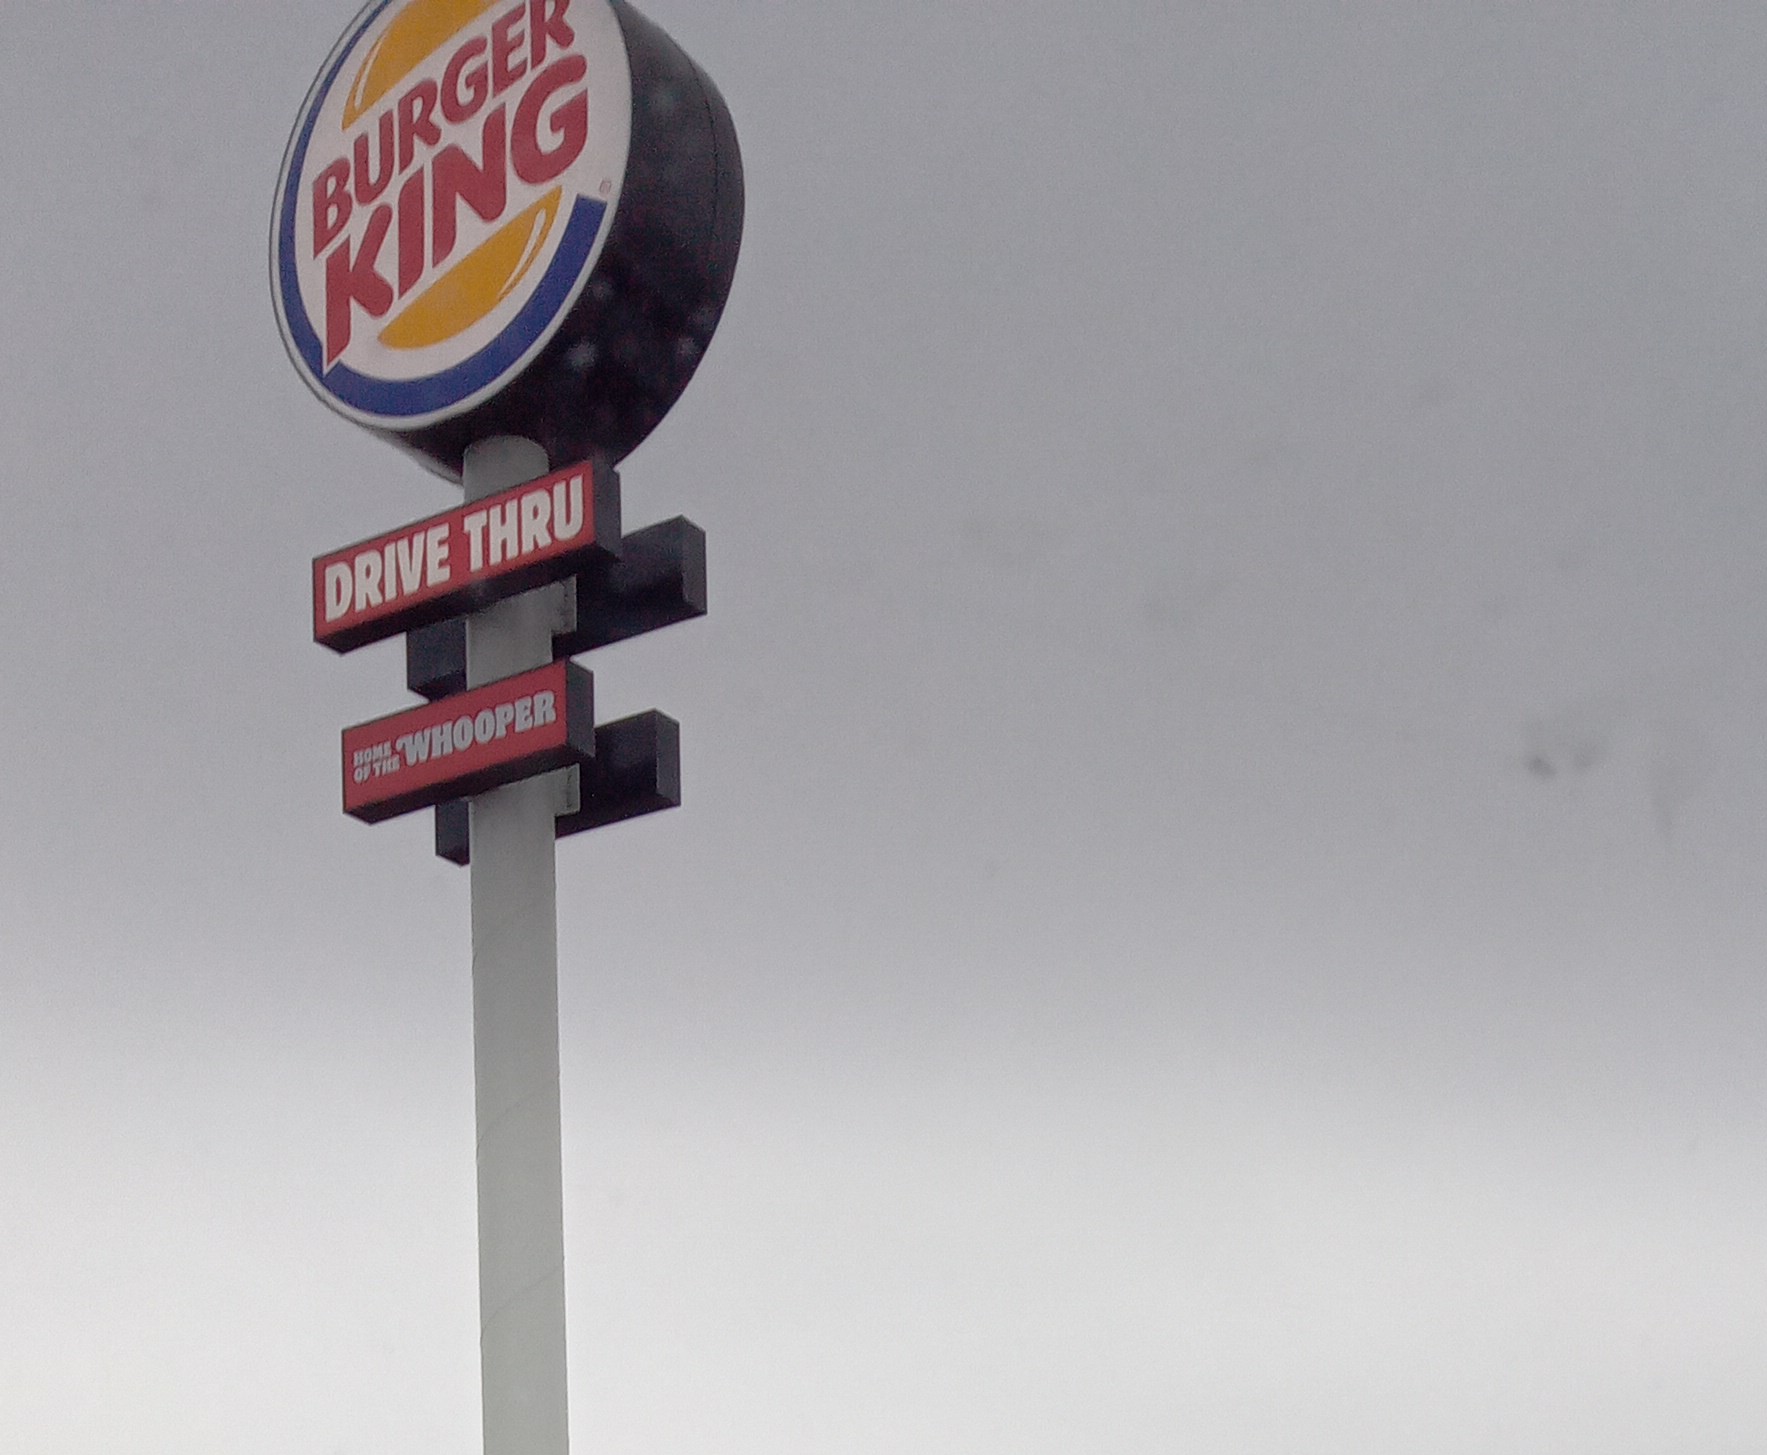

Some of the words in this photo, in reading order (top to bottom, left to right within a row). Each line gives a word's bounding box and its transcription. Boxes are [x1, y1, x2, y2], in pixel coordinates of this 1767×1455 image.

[313, 0, 575, 260] BURGER
[325, 53, 589, 366] KING
[324, 522, 452, 624] DRIVE
[463, 474, 584, 573] THRU
[353, 741, 392, 768] HOME
[353, 763, 371, 784] OF
[372, 754, 400, 778] THE
[395, 690, 556, 767] WHOOPER
